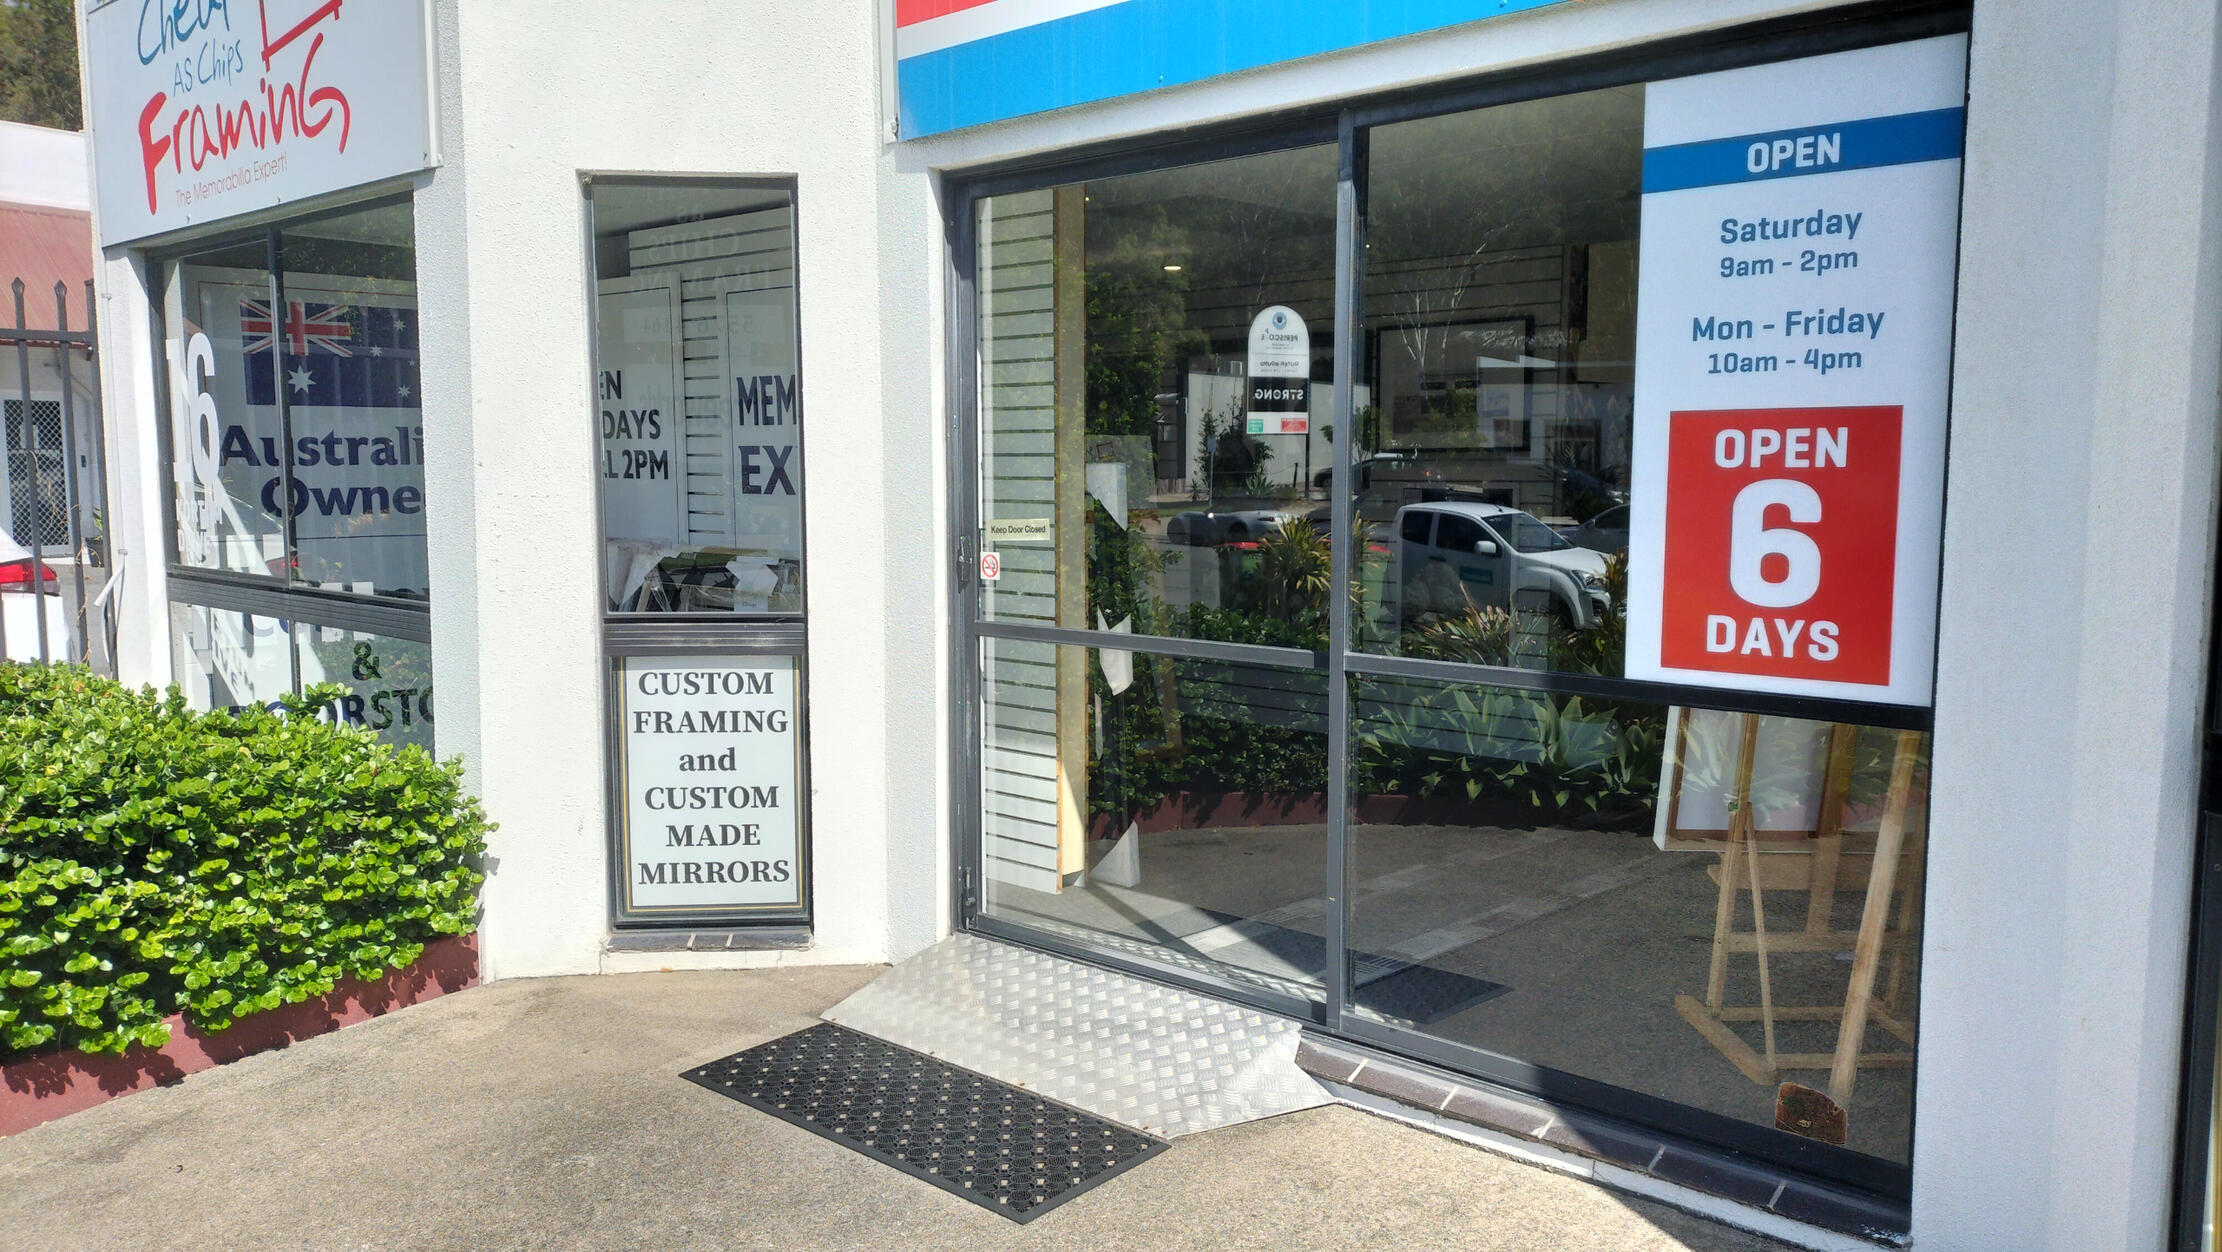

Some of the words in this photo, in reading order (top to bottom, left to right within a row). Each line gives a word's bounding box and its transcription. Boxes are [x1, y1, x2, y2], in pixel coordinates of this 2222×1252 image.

[173, 58, 193, 96] AS
[1747, 132, 1841, 174] OPEN
[176, 189, 192, 208] The
[193, 165, 252, 202] Memorabilia
[253, 150, 288, 182] Expert!
[1720, 208, 1863, 245] Saturday
[1720, 256, 1774, 278] 9am
[1800, 249, 1859, 277] 2pm
[1692, 316, 1753, 342] Mon
[1785, 306, 1885, 340] Friday
[1708, 353, 1778, 375] 10am
[1803, 348, 1862, 376] 4pm
[736, 374, 797, 426] MEM
[602, 409, 661, 440] DAYS
[622, 449, 669, 480] 2PM
[1715, 426, 1849, 469] OPEN
[738, 445, 799, 495] EX
[261, 477, 426, 517] Owne
[991, 526, 1007, 534] Keep
[1025, 525, 1046, 533] Closed
[1729, 478, 1823, 609] 6
[1706, 614, 1840, 662] DAYS
[353, 642, 383, 681] &
[638, 672, 774, 695] CUSTOM
[633, 710, 789, 733] FRAMING
[679, 747, 737, 771] and
[644, 786, 779, 810] CUSTOM
[665, 824, 761, 847] MADE
[638, 860, 790, 884] MIRRORS
